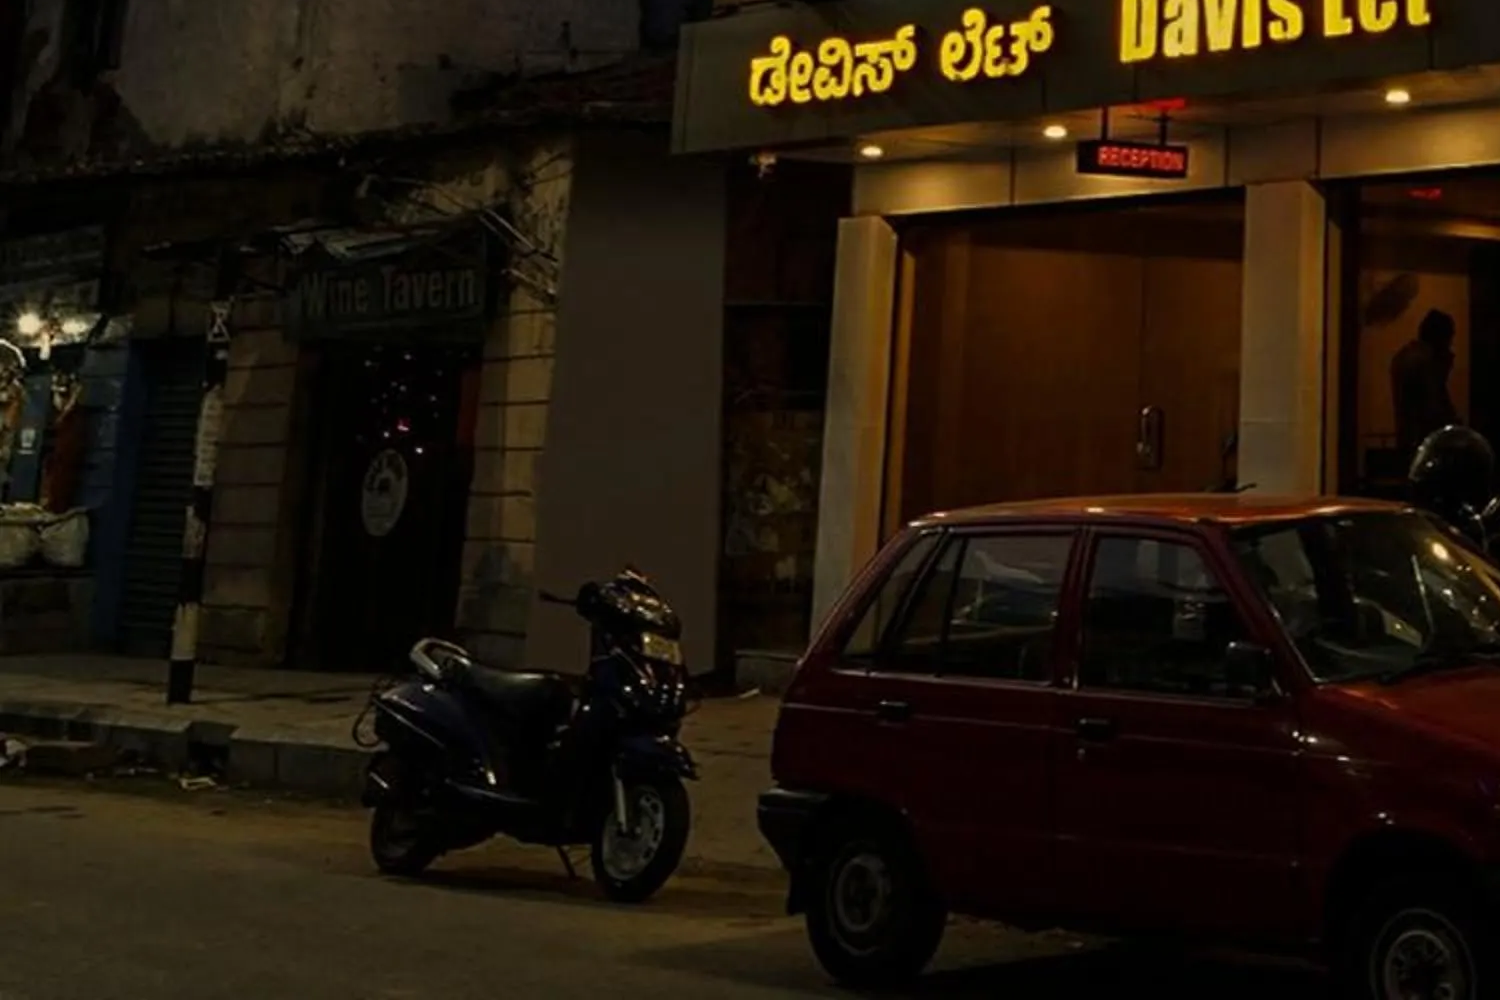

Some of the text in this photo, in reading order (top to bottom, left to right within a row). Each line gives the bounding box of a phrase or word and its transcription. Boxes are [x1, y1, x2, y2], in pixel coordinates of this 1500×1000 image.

[1098, 146, 1184, 170] RECEPTION
[304, 264, 477, 320] Wine Tavern
